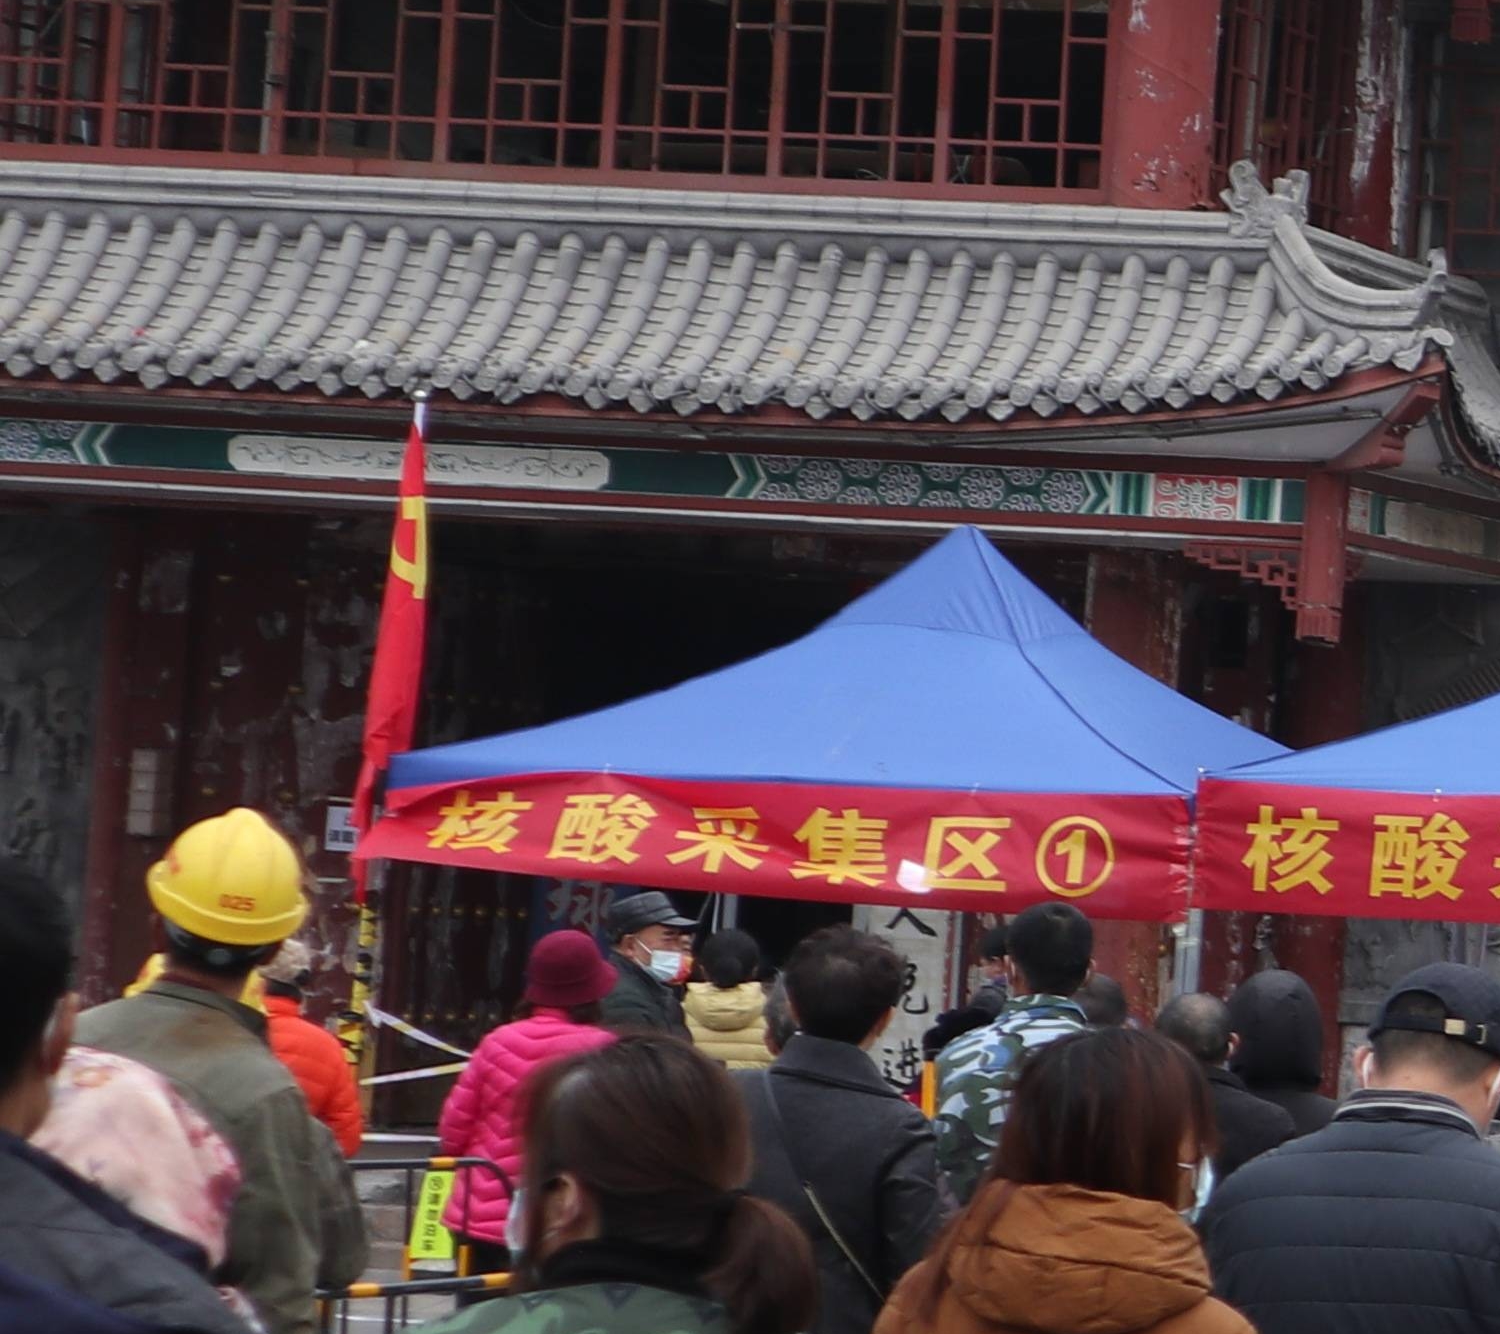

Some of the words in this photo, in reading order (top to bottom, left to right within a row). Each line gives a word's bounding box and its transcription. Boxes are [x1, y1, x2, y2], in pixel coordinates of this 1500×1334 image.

[426, 790, 1114, 897] 核酸采集区①
